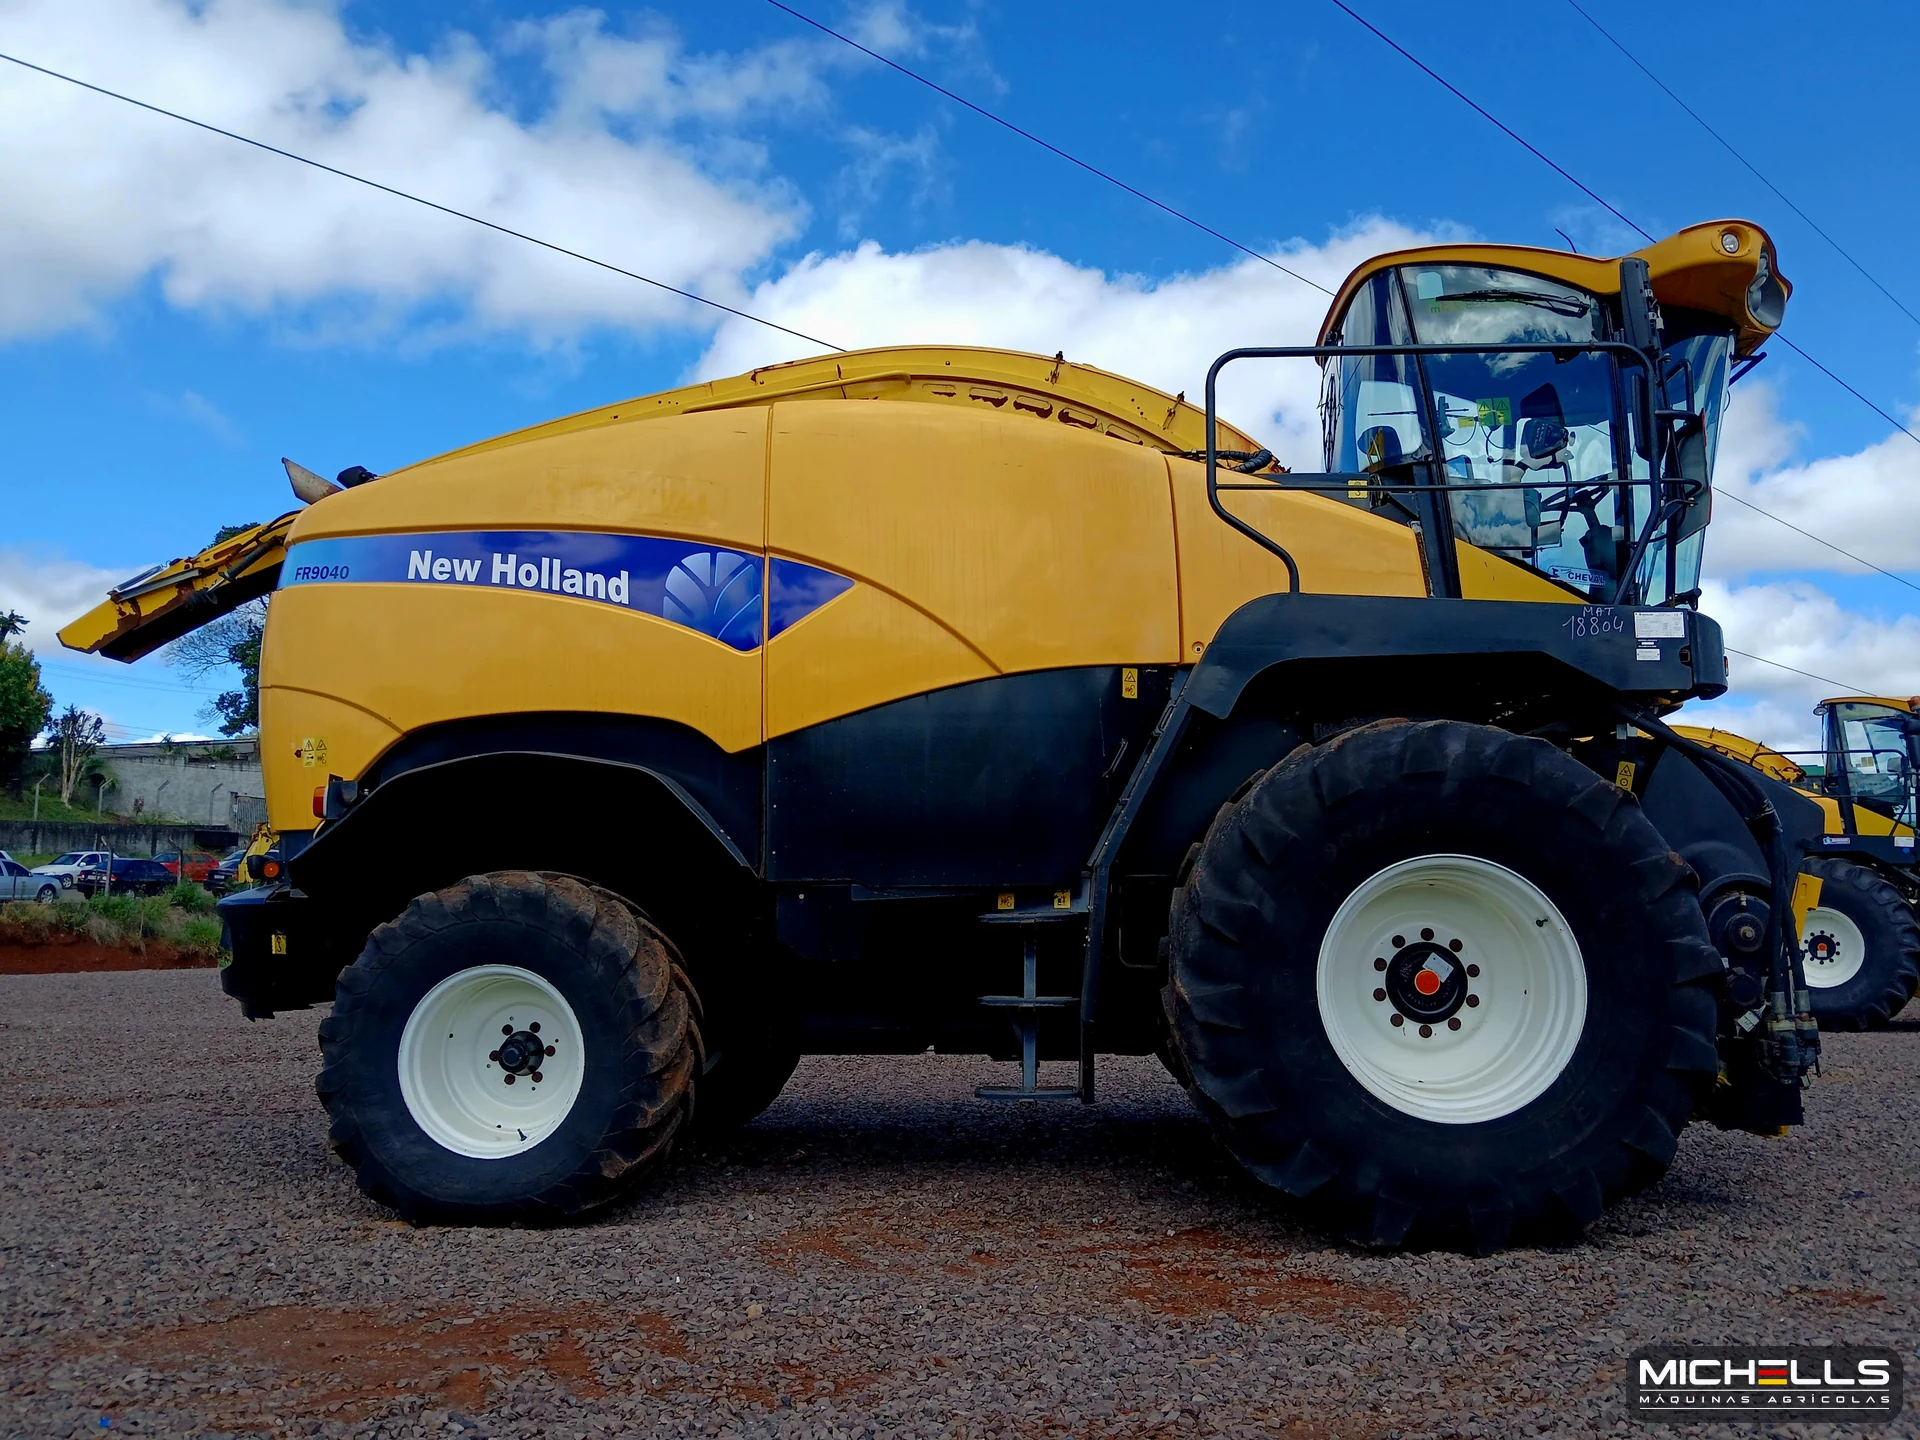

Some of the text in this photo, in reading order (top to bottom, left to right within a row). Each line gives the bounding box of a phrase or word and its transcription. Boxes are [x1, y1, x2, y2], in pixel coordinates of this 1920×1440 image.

[294, 550, 630, 605] FR9040 New Holland
[1567, 572, 1606, 584] CHEVAL
[1582, 606, 1615, 618] MAT
[1562, 615, 1625, 640] 18804
